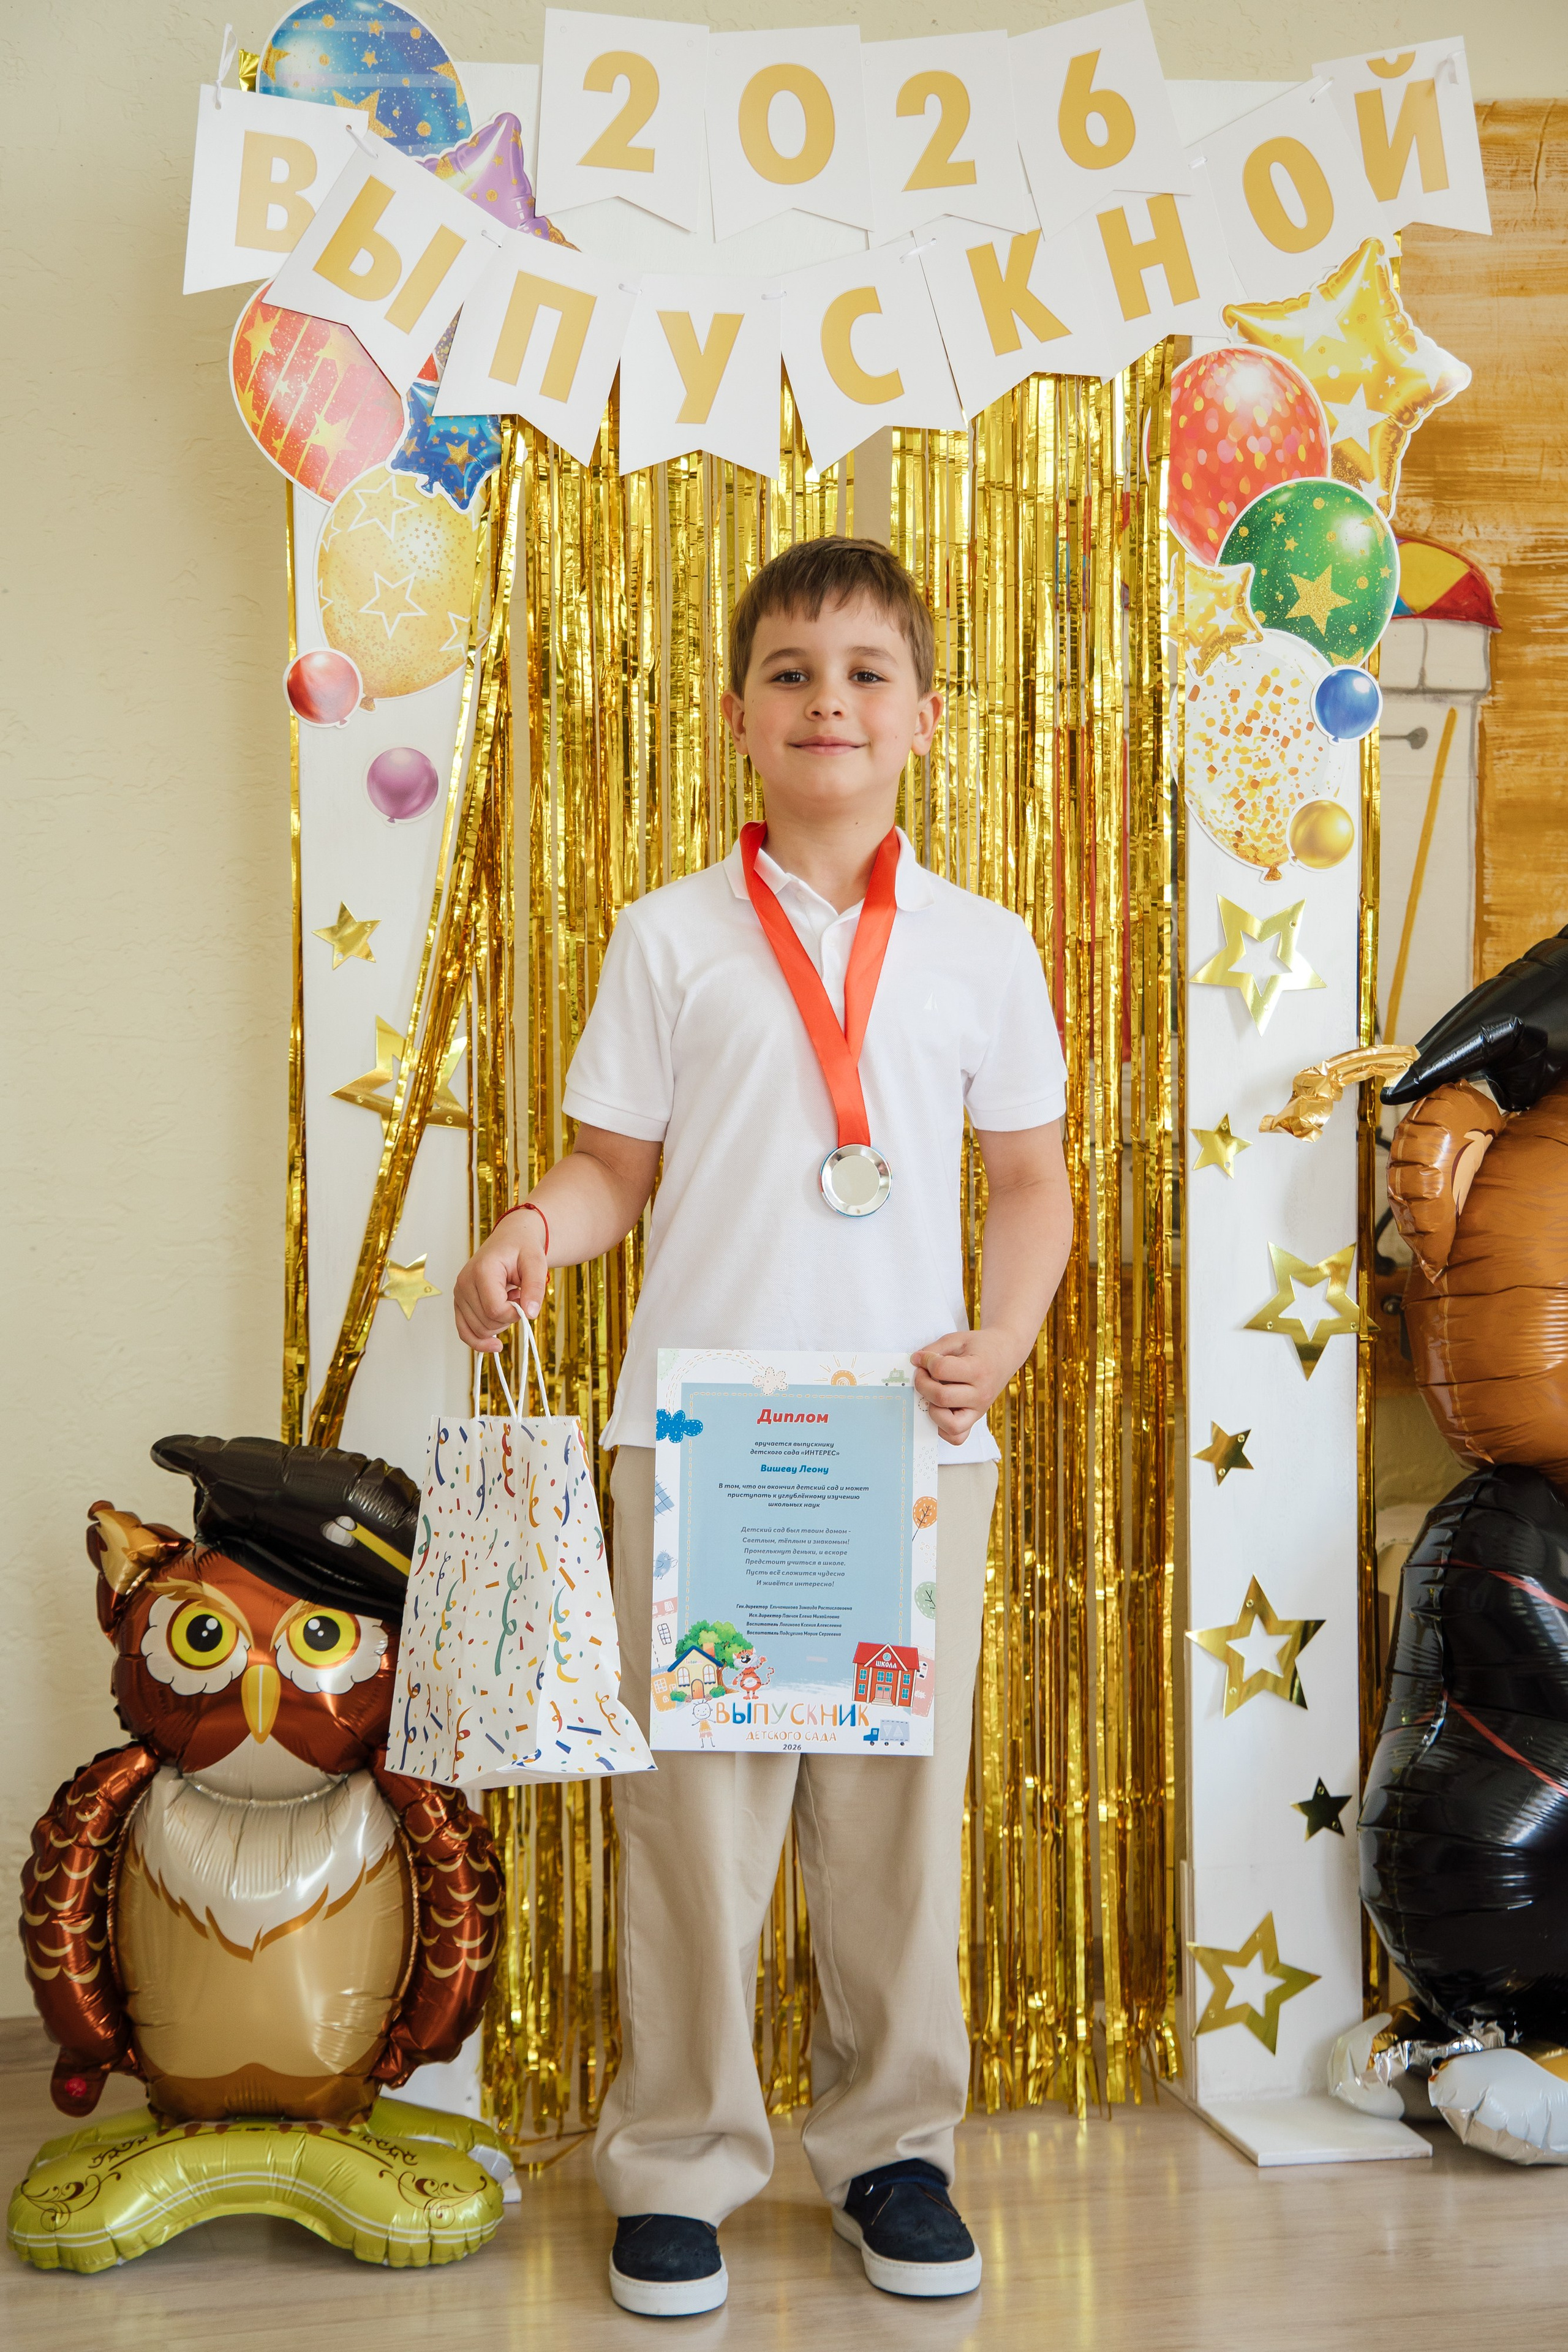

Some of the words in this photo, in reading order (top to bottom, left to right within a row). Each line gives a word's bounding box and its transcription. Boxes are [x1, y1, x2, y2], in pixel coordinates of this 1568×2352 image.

[576, 49, 1135, 192] 2026
[235, 51, 1450, 424] ВЫПУСКНОЙ
[757, 1409, 829, 1425] Диплом
[760, 1463, 797, 1475] Вишеву
[798, 1464, 829, 1476] Леону
[744, 1547, 791, 1556] Промелькнут
[716, 1702, 869, 1727] ВЫПУСКНИК
[746, 1731, 801, 1741] ДЕТСКОГО
[805, 1732, 837, 1743] САДА
